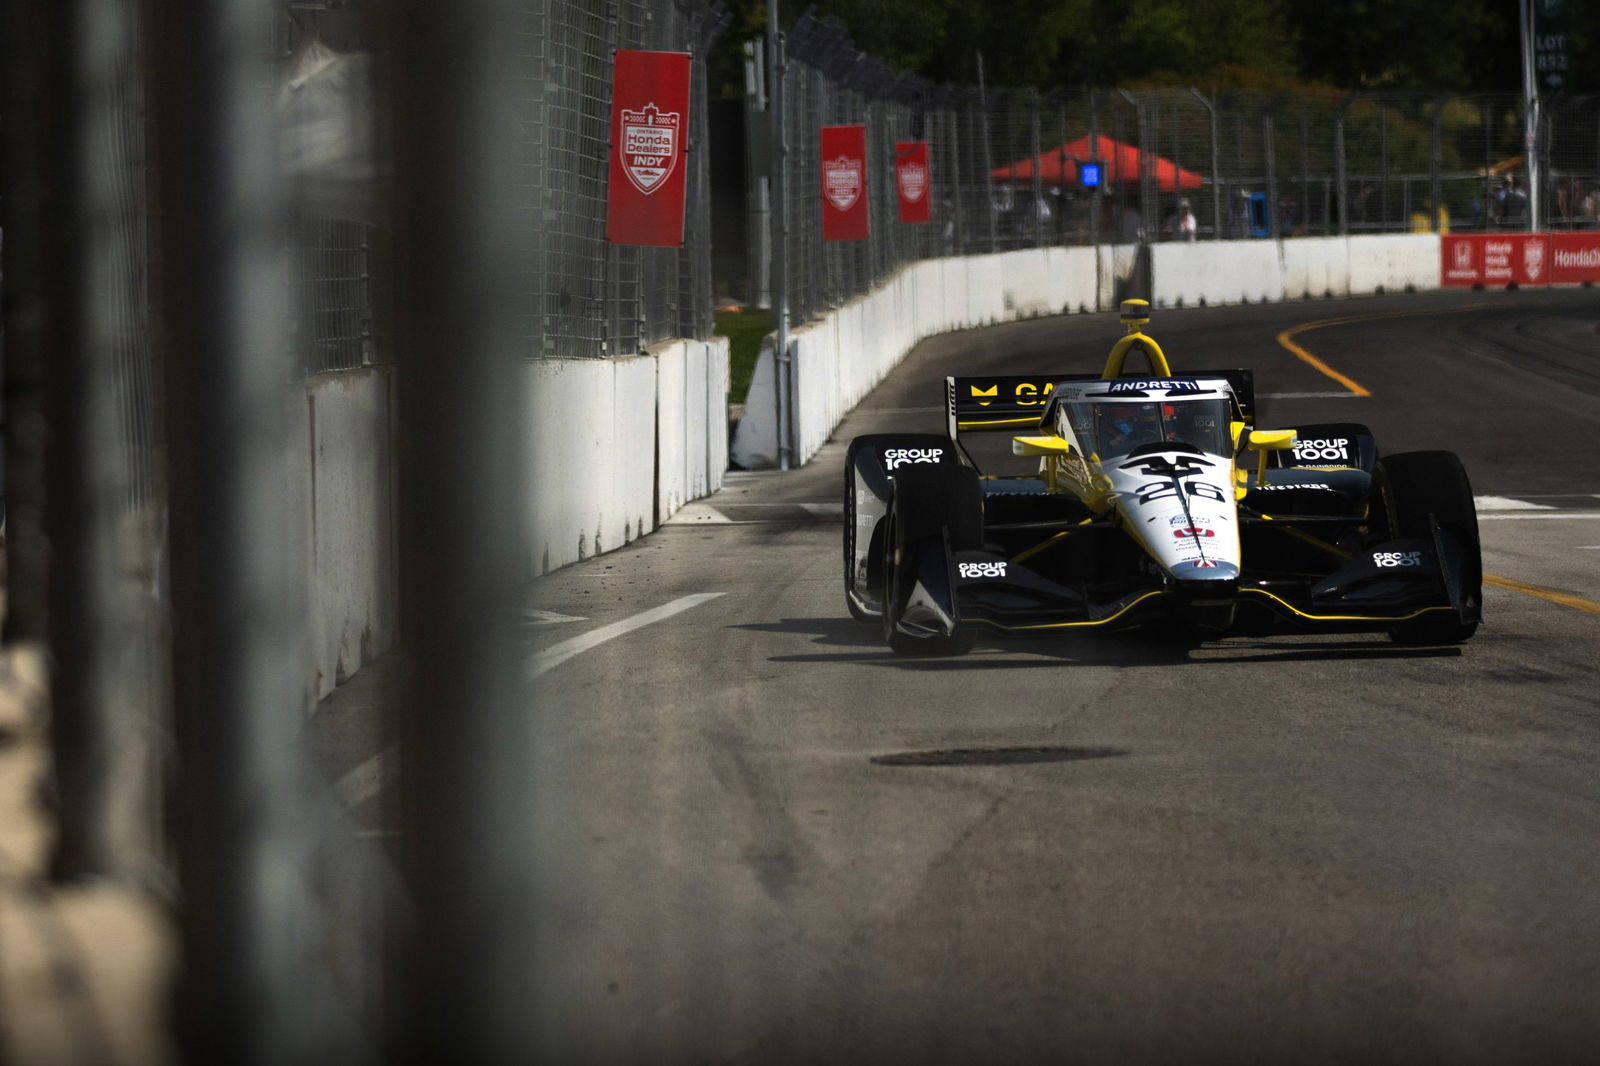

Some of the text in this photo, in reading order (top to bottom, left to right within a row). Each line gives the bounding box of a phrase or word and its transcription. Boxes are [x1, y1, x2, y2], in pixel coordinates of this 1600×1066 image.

[628, 134, 670, 145] Honda
[628, 144, 670, 154] Dealers
[633, 155, 665, 167] INDY
[1110, 380, 1199, 392] ANDRETTI
[884, 448, 943, 459] GROUP
[1292, 448, 1349, 460] 1001
[1135, 481, 1226, 505] 26
[1372, 551, 1421, 560] GROUP
[958, 561, 1007, 571] GROUP
[1374, 558, 1421, 567] 1001
[959, 569, 1006, 578] 1001
